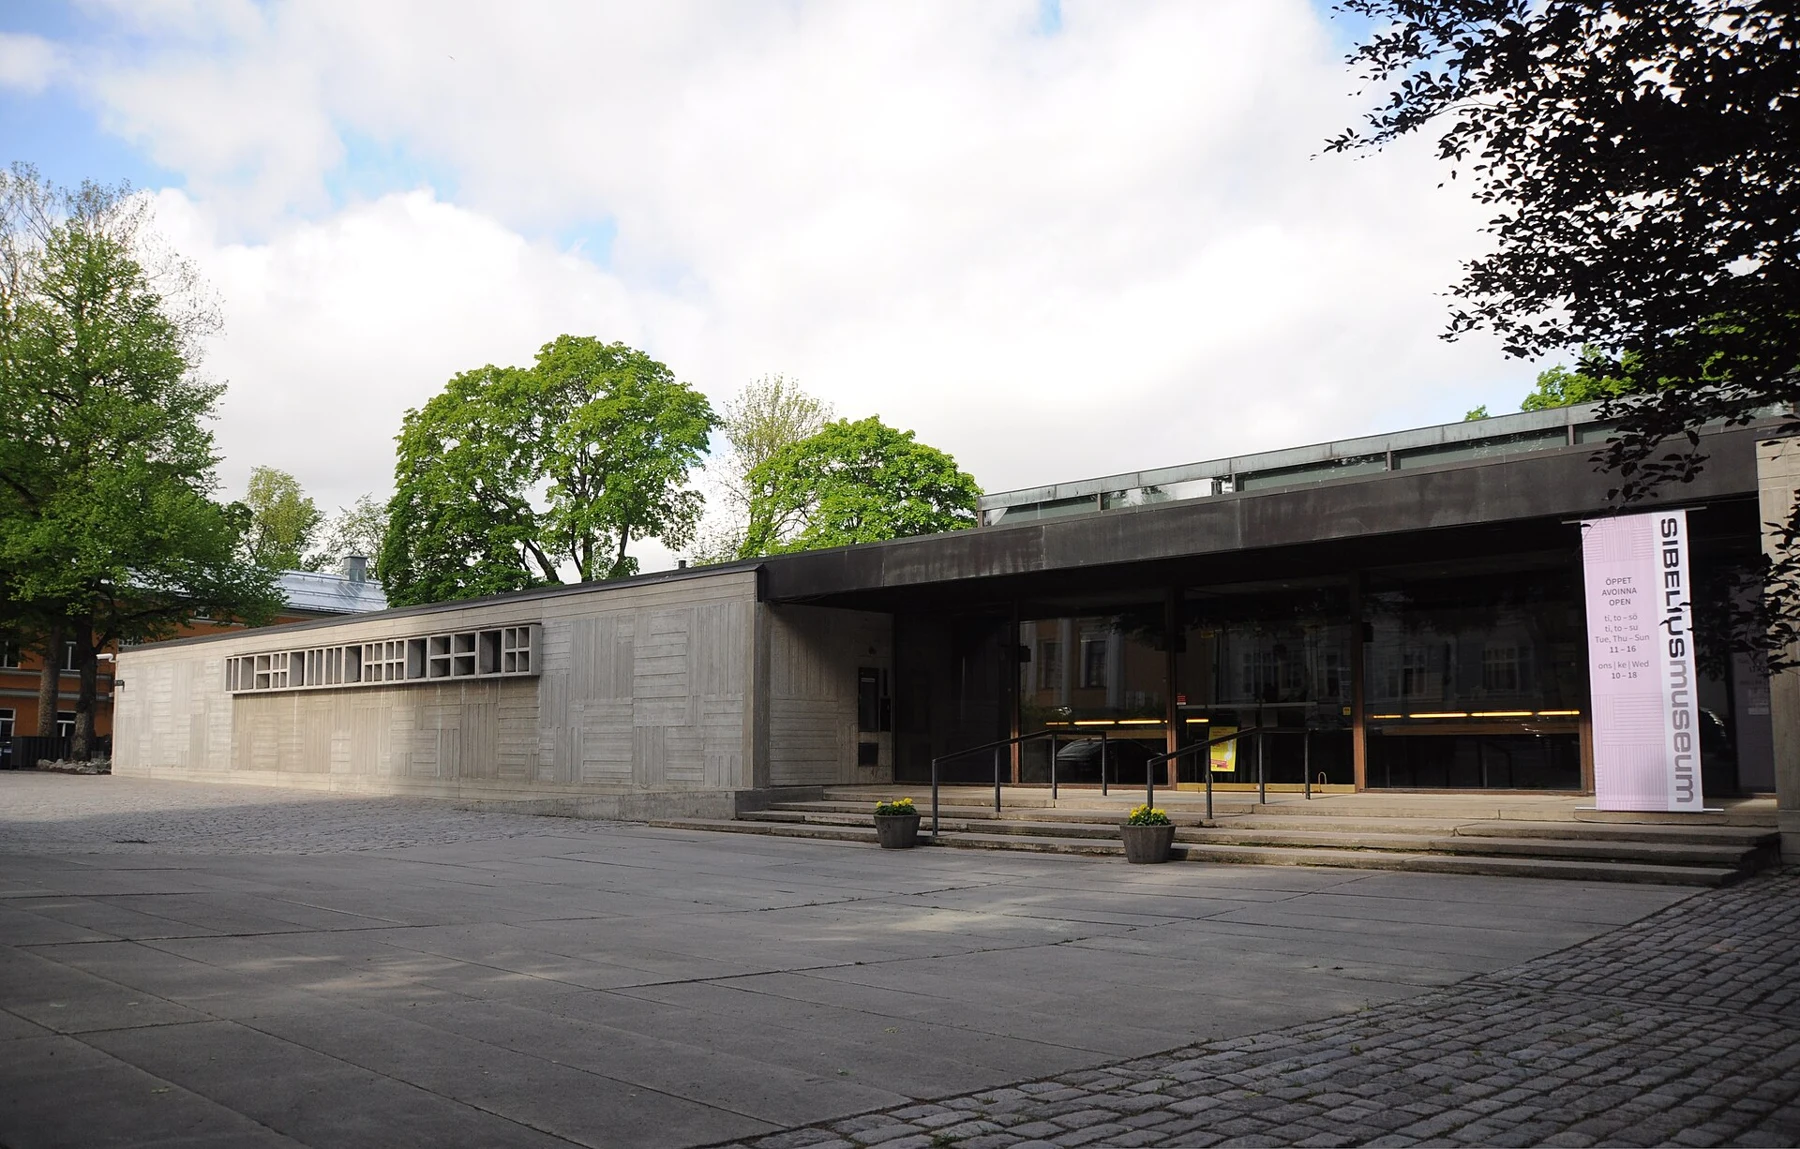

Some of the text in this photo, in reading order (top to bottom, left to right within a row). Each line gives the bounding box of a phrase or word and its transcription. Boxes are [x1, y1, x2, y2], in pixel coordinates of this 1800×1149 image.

[1605, 576, 1632, 585] ÖPPET
[1601, 587, 1637, 596] AVOINNA
[1609, 598, 1631, 606] OPEN
[1627, 645, 1637, 653] 16
[1631, 660, 1649, 668] Wed
[1628, 671, 1637, 679] 18
